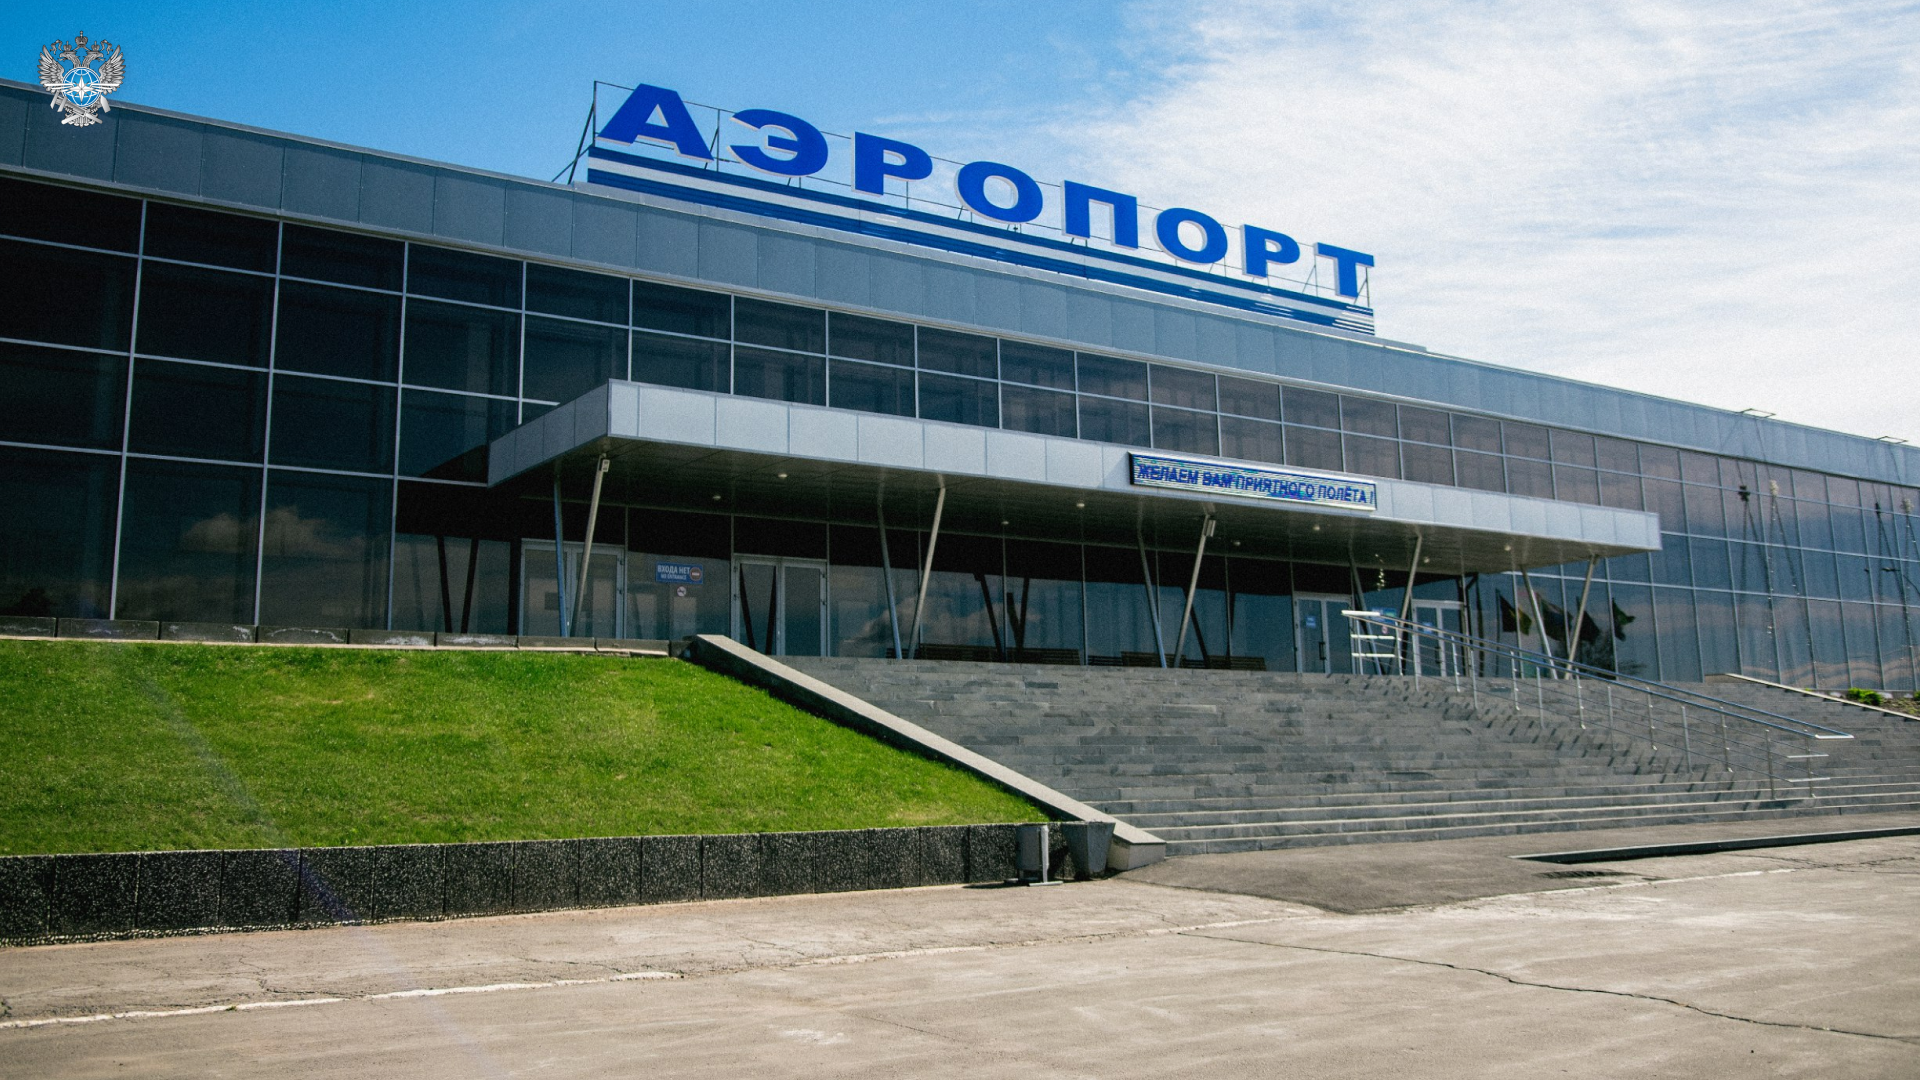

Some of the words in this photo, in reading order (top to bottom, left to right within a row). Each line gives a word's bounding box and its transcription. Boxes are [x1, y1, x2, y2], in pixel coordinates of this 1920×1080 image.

[596, 83, 1374, 299] АЭРОПОРТ
[1137, 463, 1198, 485] ЖЕЛАЕМ
[1202, 471, 1232, 488] ВАМ
[1235, 475, 1315, 498] ПРИЯТНОГО
[657, 564, 678, 574] ВХОДА
[678, 566, 690, 574] НЕТ
